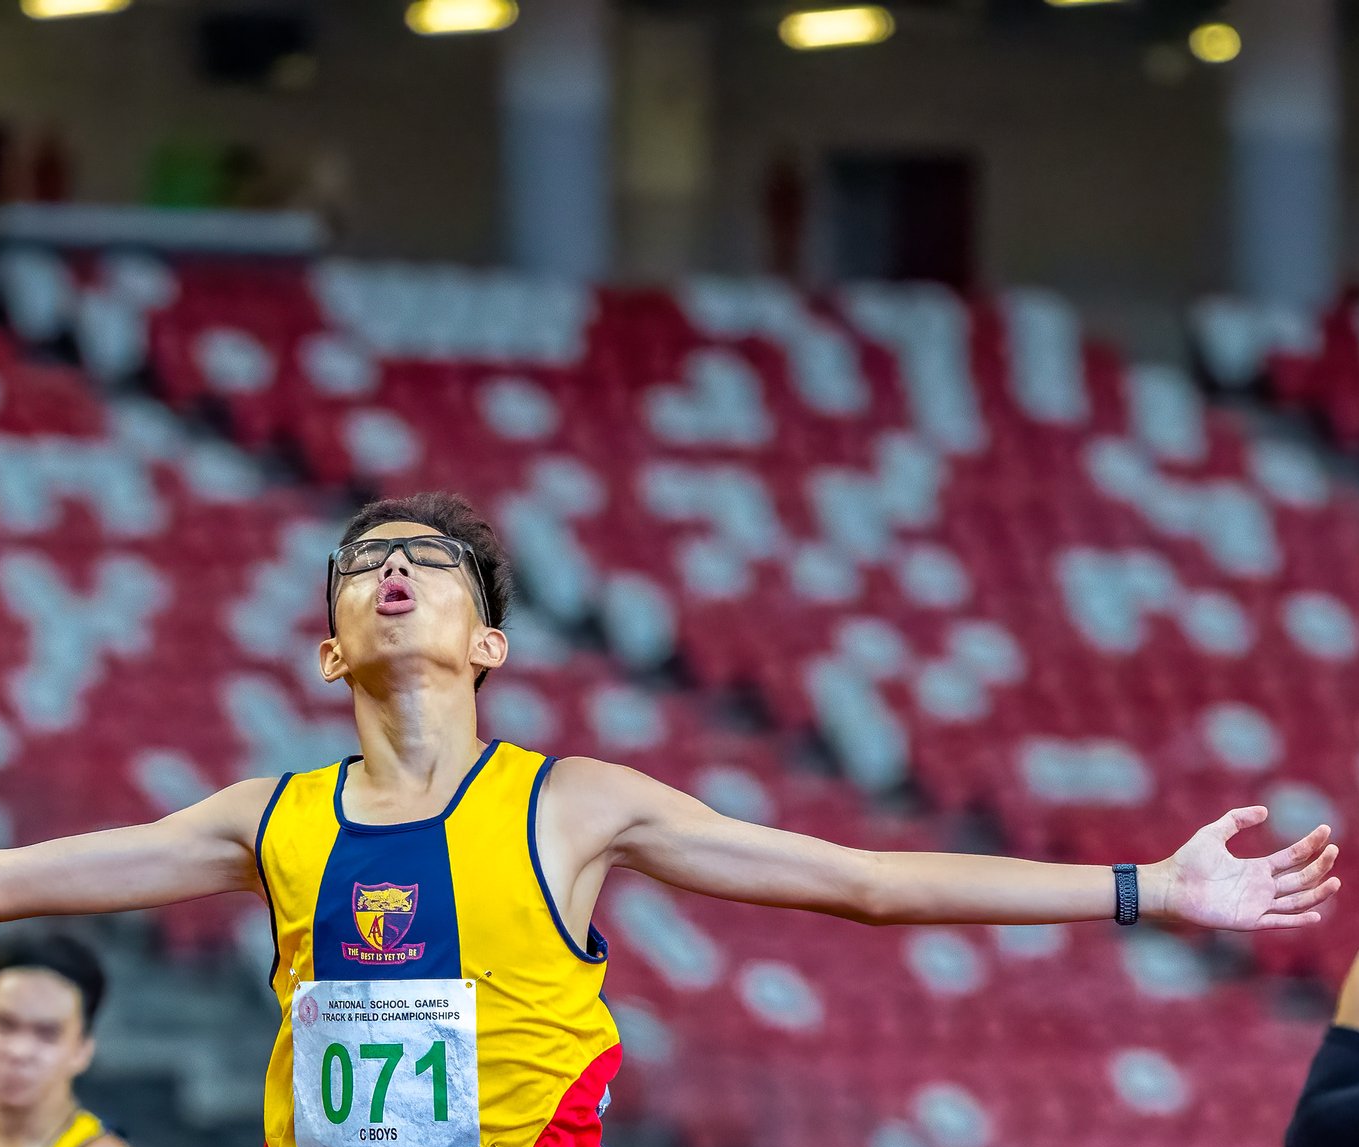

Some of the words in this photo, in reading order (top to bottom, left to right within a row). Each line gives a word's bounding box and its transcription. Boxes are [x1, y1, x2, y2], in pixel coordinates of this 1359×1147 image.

[347, 947, 359, 956] THE
[360, 952, 375, 960] BEST
[376, 953, 383, 961] IS
[384, 953, 396, 961] YET
[396, 952, 406, 960] TO
[408, 948, 417, 956] BE
[328, 1000, 366, 1009] NATIONAL
[370, 1000, 410, 1009] SCHOOL
[414, 999, 449, 1008] GAMES
[322, 1012, 346, 1022] TRACK
[347, 1013, 353, 1021] &
[354, 1012, 379, 1022] FIELD
[381, 1011, 460, 1021] CHAMPIONSHIPS
[321, 1041, 448, 1125] 071
[359, 1128, 367, 1141] C
[369, 1127, 398, 1141] BOYS
